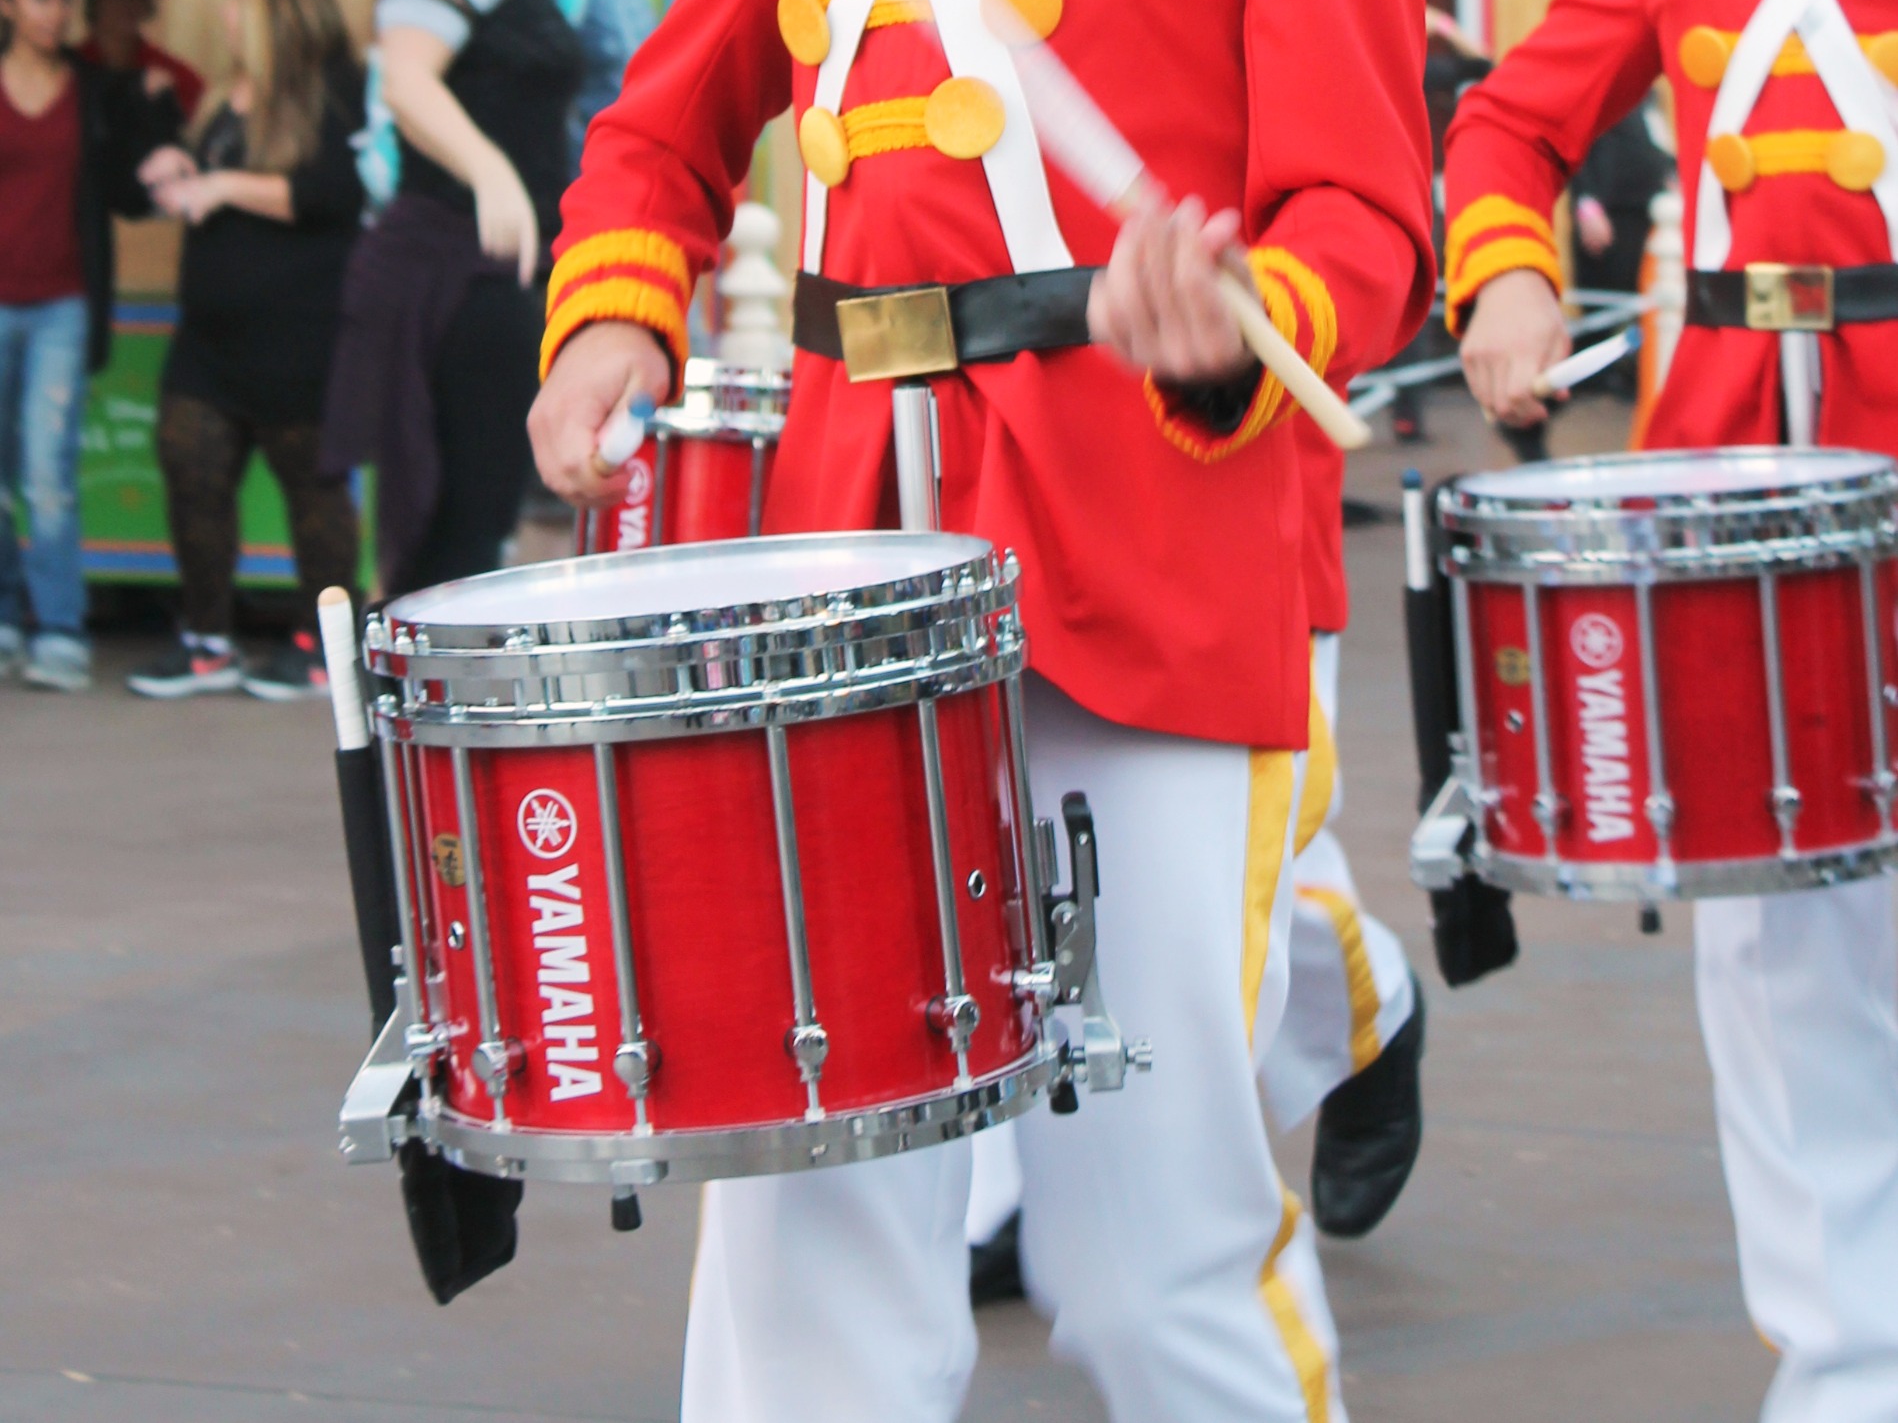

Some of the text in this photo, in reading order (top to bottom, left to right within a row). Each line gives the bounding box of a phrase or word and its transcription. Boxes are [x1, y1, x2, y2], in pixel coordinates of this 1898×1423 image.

[617, 505, 648, 551] YA
[1576, 669, 1635, 843] YAMAHA
[527, 863, 603, 1102] YAMAHA
